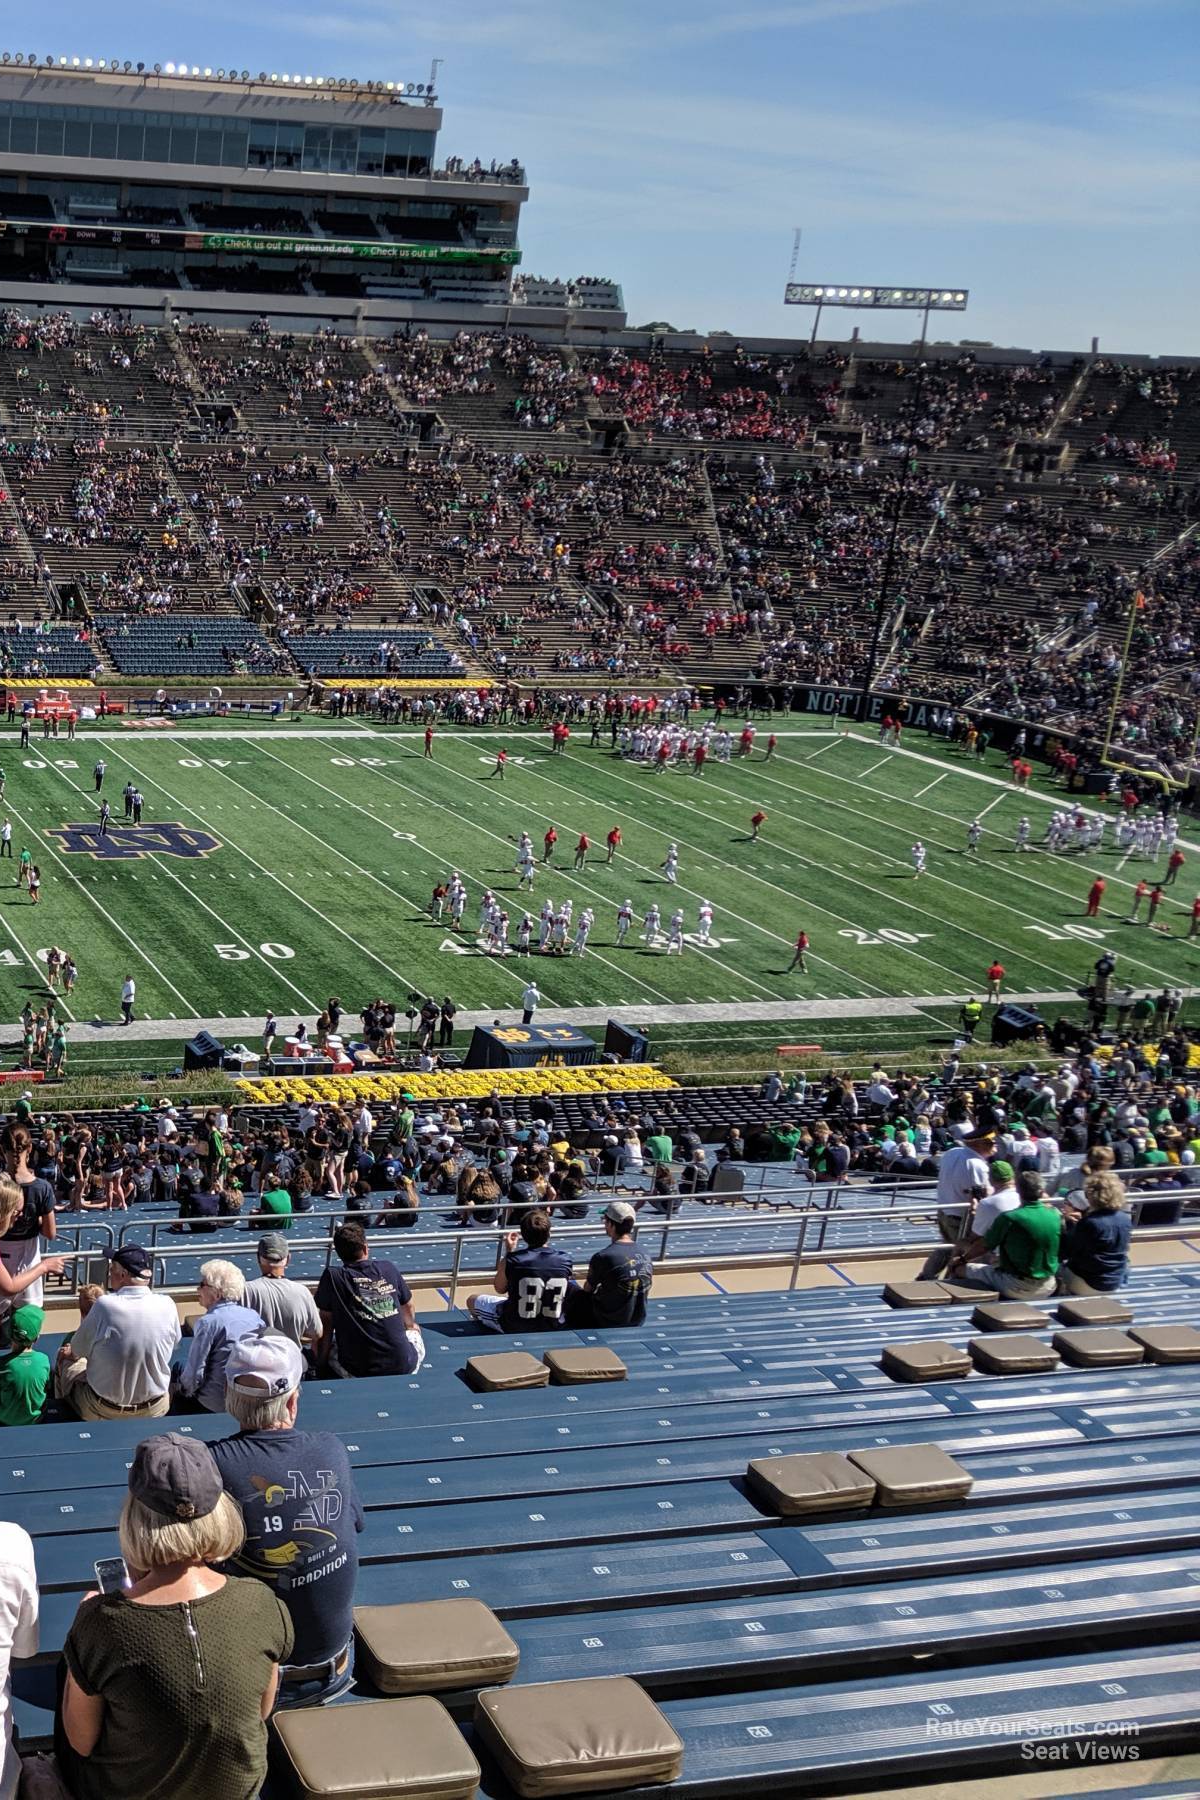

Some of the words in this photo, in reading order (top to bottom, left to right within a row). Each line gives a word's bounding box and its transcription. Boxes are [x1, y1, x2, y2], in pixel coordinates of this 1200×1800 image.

[76, 231, 96, 239] DOWN
[224, 239, 251, 248] Check
[253, 241, 264, 249] us
[266, 241, 281, 250] out
[283, 242, 293, 251] at
[295, 243, 354, 254] green.nd.edu
[370, 246, 397, 256] Check
[400, 249, 409, 257] us
[412, 249, 426, 258] out
[428, 249, 437, 258] at
[837, 928, 919, 946] 20
[1026, 924, 1102, 941] 10
[213, 942, 295, 960] 50
[518, 1277, 568, 1319] 83
[264, 1515, 283, 1533] 19
[308, 1550, 325, 1564] BUILT
[328, 1543, 337, 1553] ON
[291, 1551, 348, 1588] TRADITION
[747, 1622, 763, 1631] 31
[585, 1638, 601, 1647] 32
[1104, 1684, 1123, 1695] 30
[932, 1704, 950, 1714] 31
[750, 1726, 769, 1737] 32
